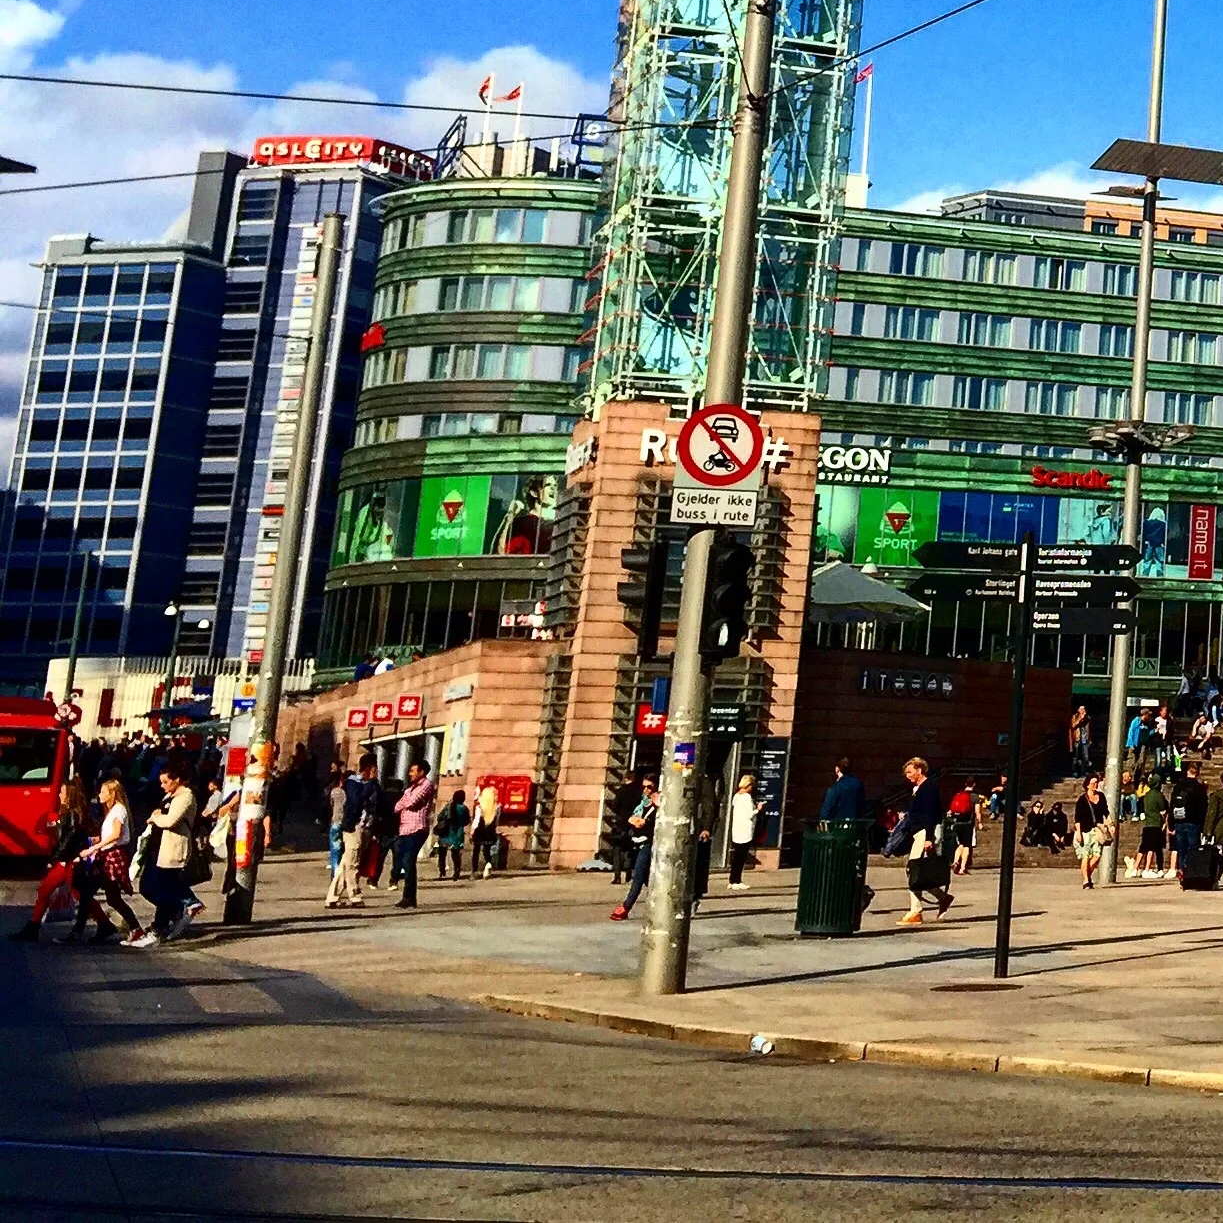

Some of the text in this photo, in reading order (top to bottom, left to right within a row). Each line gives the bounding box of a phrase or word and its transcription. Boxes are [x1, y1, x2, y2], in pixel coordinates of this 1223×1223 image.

[818, 446, 891, 471] GON
[1032, 465, 1113, 490] Scandic
[676, 492, 752, 506] Gjelder ikke
[676, 508, 749, 521] buss i rute
[431, 526, 468, 540] SPORT
[1194, 509, 1209, 554] name
[873, 537, 918, 550] SPORT
